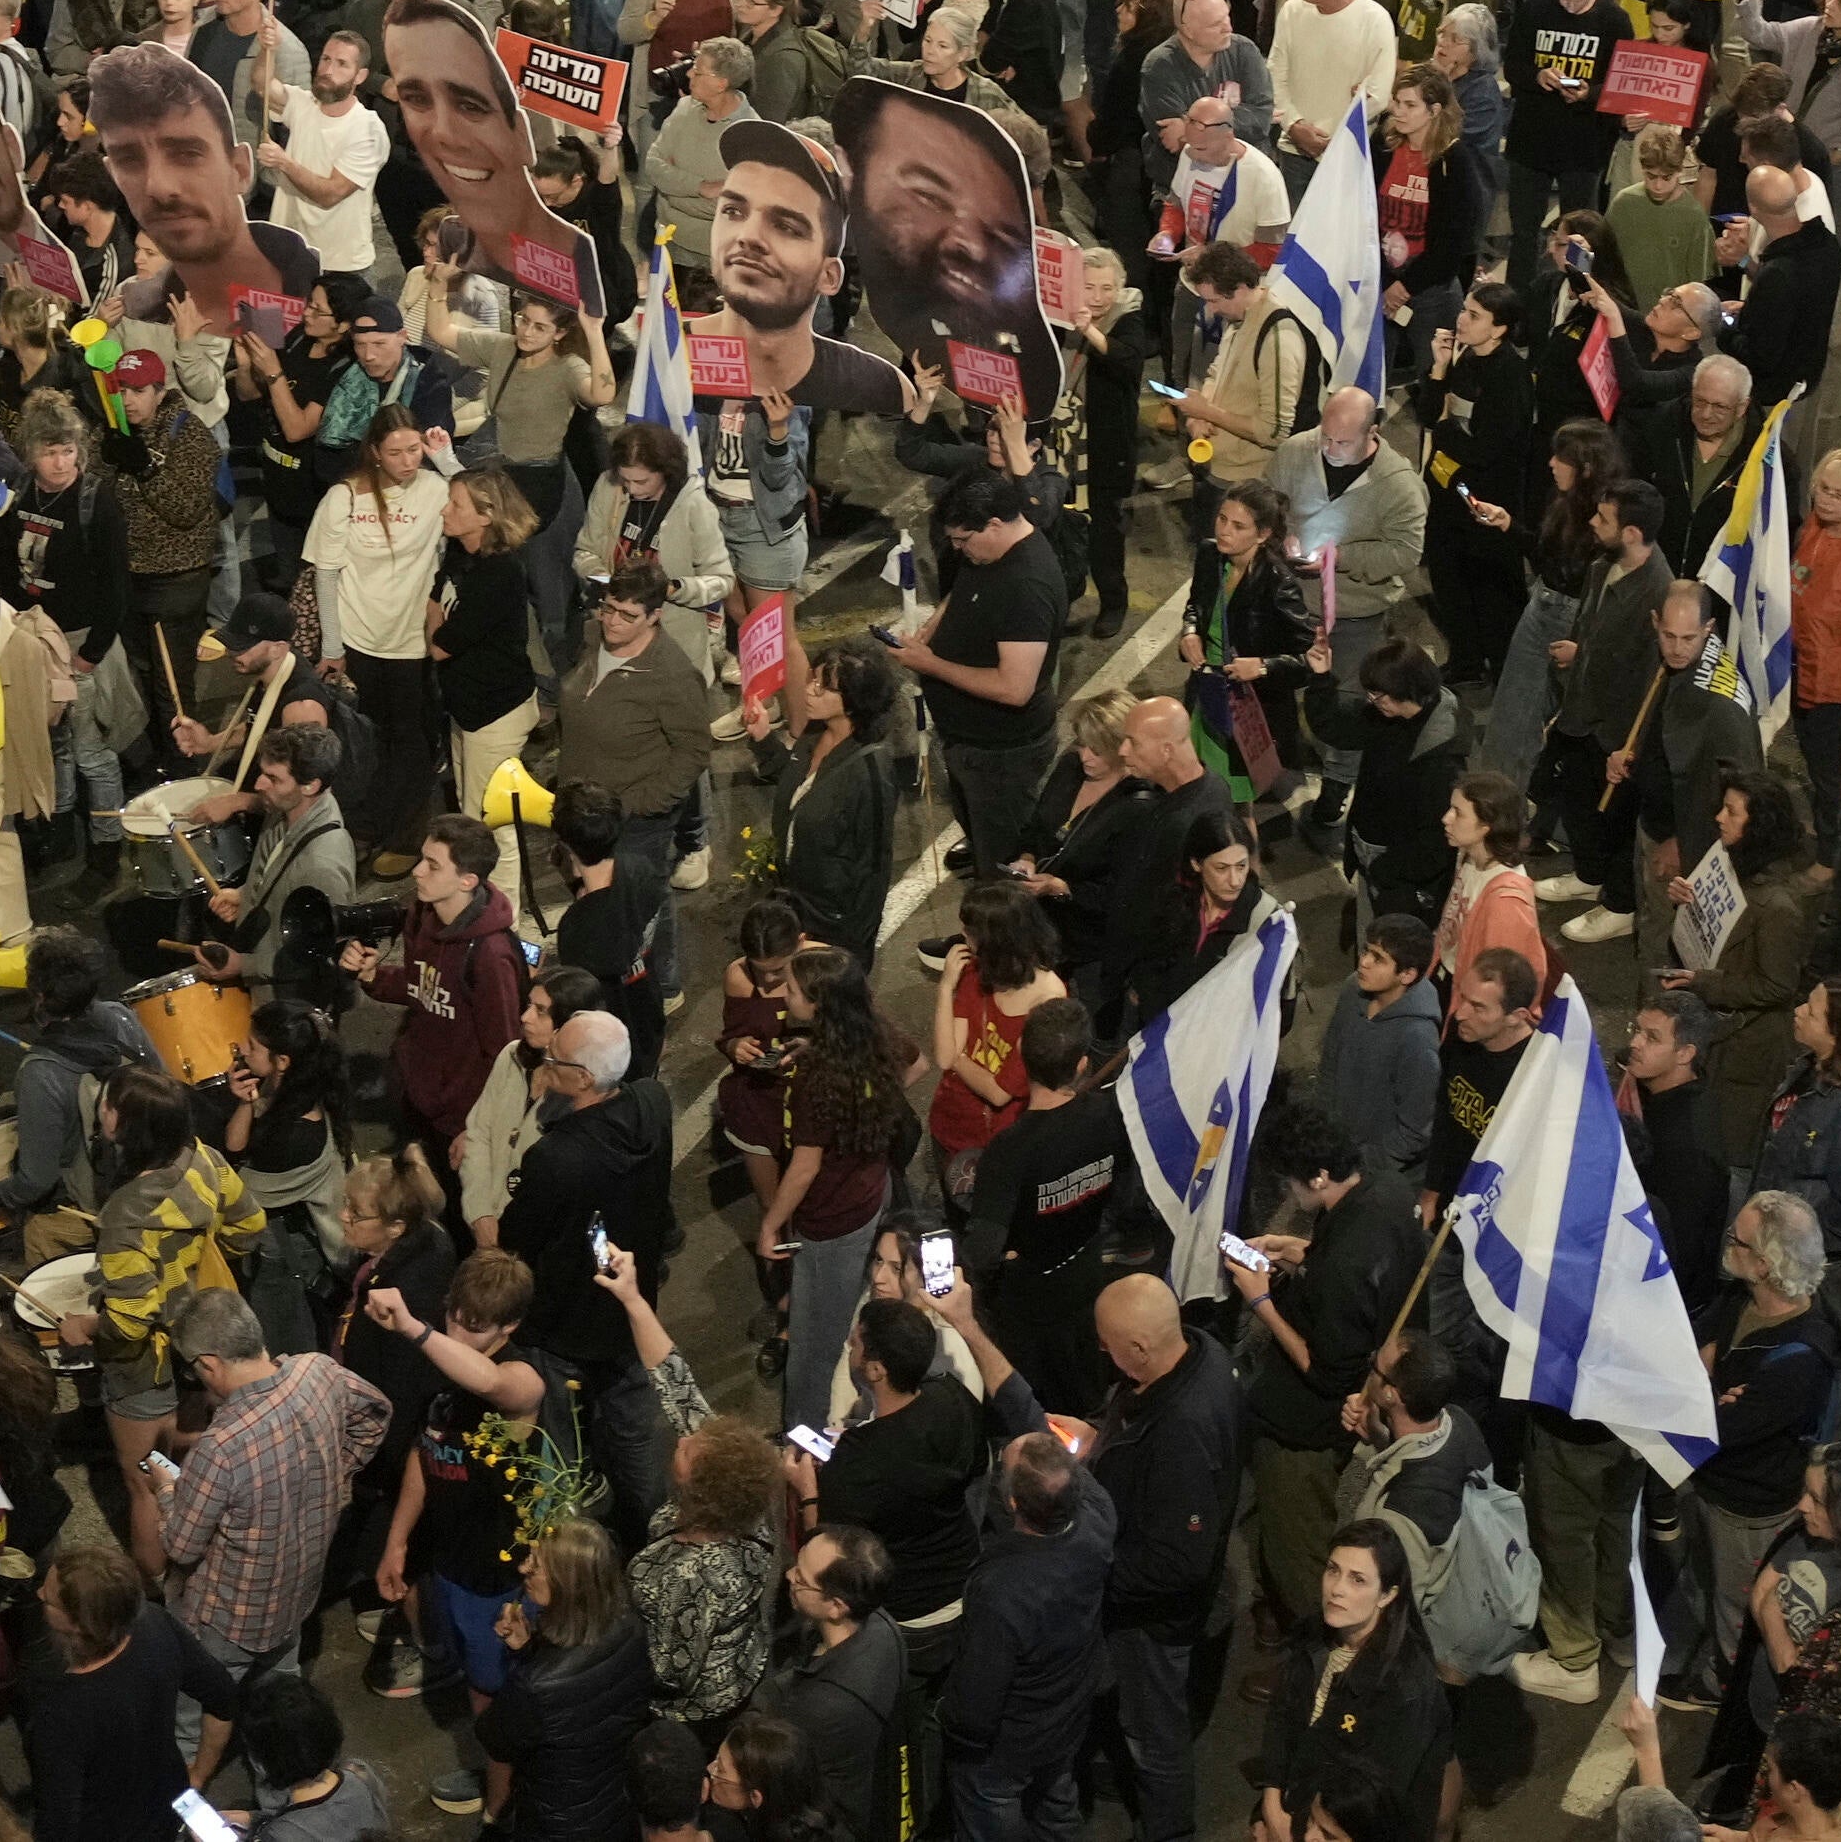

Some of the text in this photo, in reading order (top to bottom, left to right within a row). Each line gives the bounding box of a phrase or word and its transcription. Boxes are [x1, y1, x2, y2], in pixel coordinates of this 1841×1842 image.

[1535, 29, 1600, 58] בלעדיהם
[530, 48, 601, 85] מדינה
[1616, 52, 1695, 80] עד החטוף
[524, 70, 600, 108] חטופה
[1620, 76, 1681, 99] האחרון
[690, 339, 743, 358] עדיין
[1694, 666, 1715, 691] ALL
